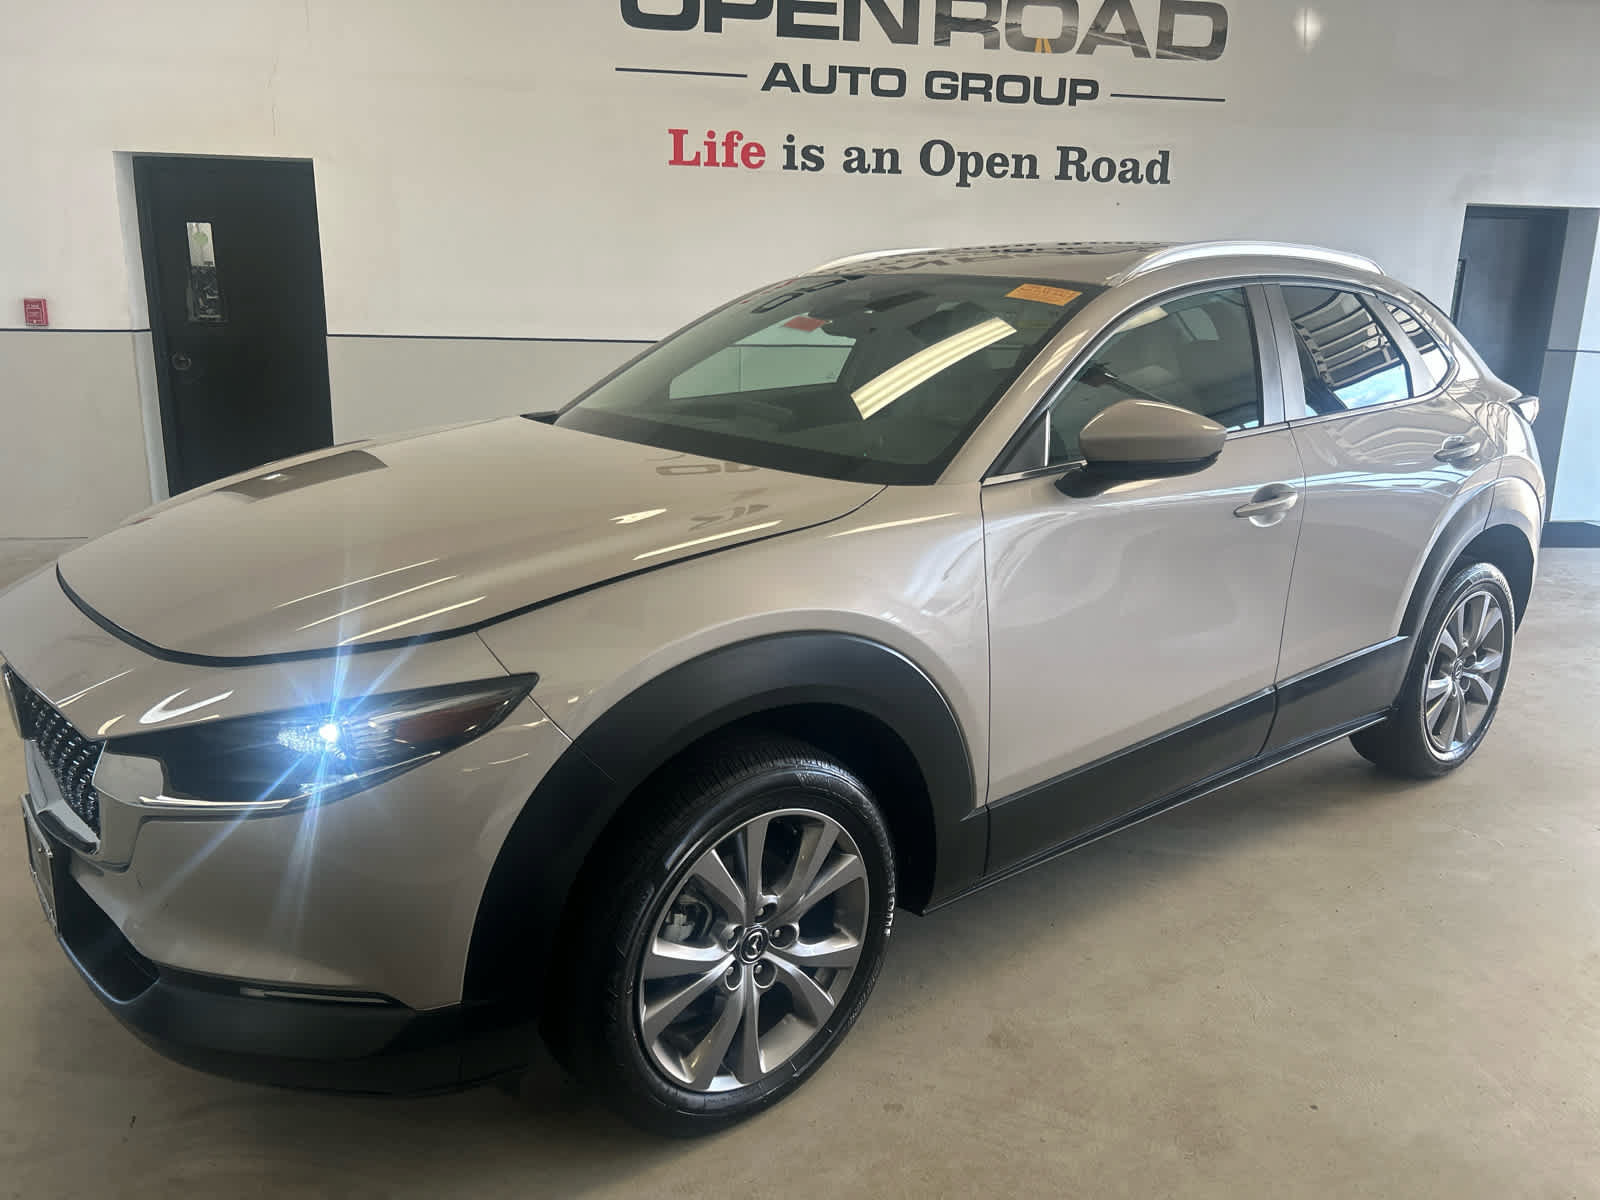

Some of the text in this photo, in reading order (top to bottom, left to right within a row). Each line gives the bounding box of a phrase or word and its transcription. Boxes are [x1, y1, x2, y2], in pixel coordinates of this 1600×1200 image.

[760, 62, 1100, 107] AUTO GROUP
[668, 128, 1171, 188] Life is an Open Road
